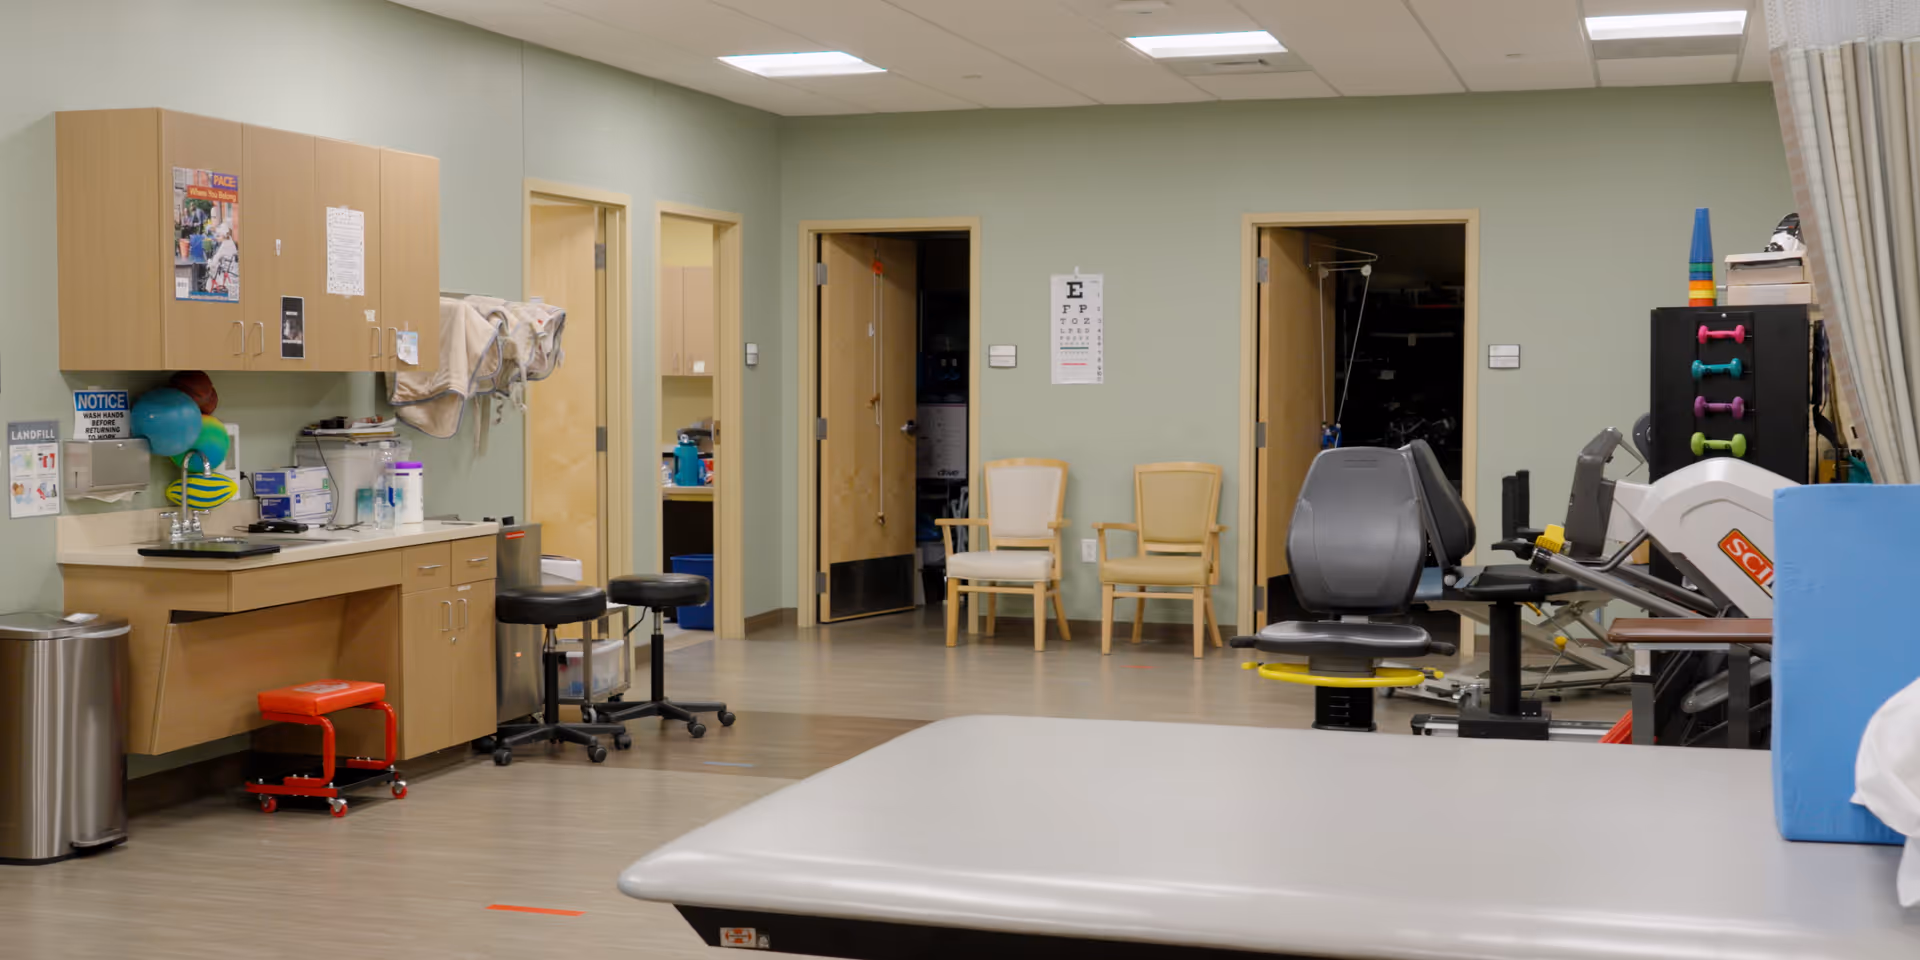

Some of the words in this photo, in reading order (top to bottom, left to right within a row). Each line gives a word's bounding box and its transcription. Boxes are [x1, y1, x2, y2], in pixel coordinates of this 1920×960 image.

[208, 189, 218, 198] You
[218, 191, 237, 203] Belong
[1066, 282, 1083, 298] E
[1062, 305, 1071, 314] F
[1079, 304, 1087, 313] P
[79, 394, 125, 409] NOTICE
[103, 411, 124, 419] HANDS
[11, 429, 55, 441] LANDFILL
[85, 426, 120, 434] RETURNING
[1726, 538, 1774, 588] SCI
